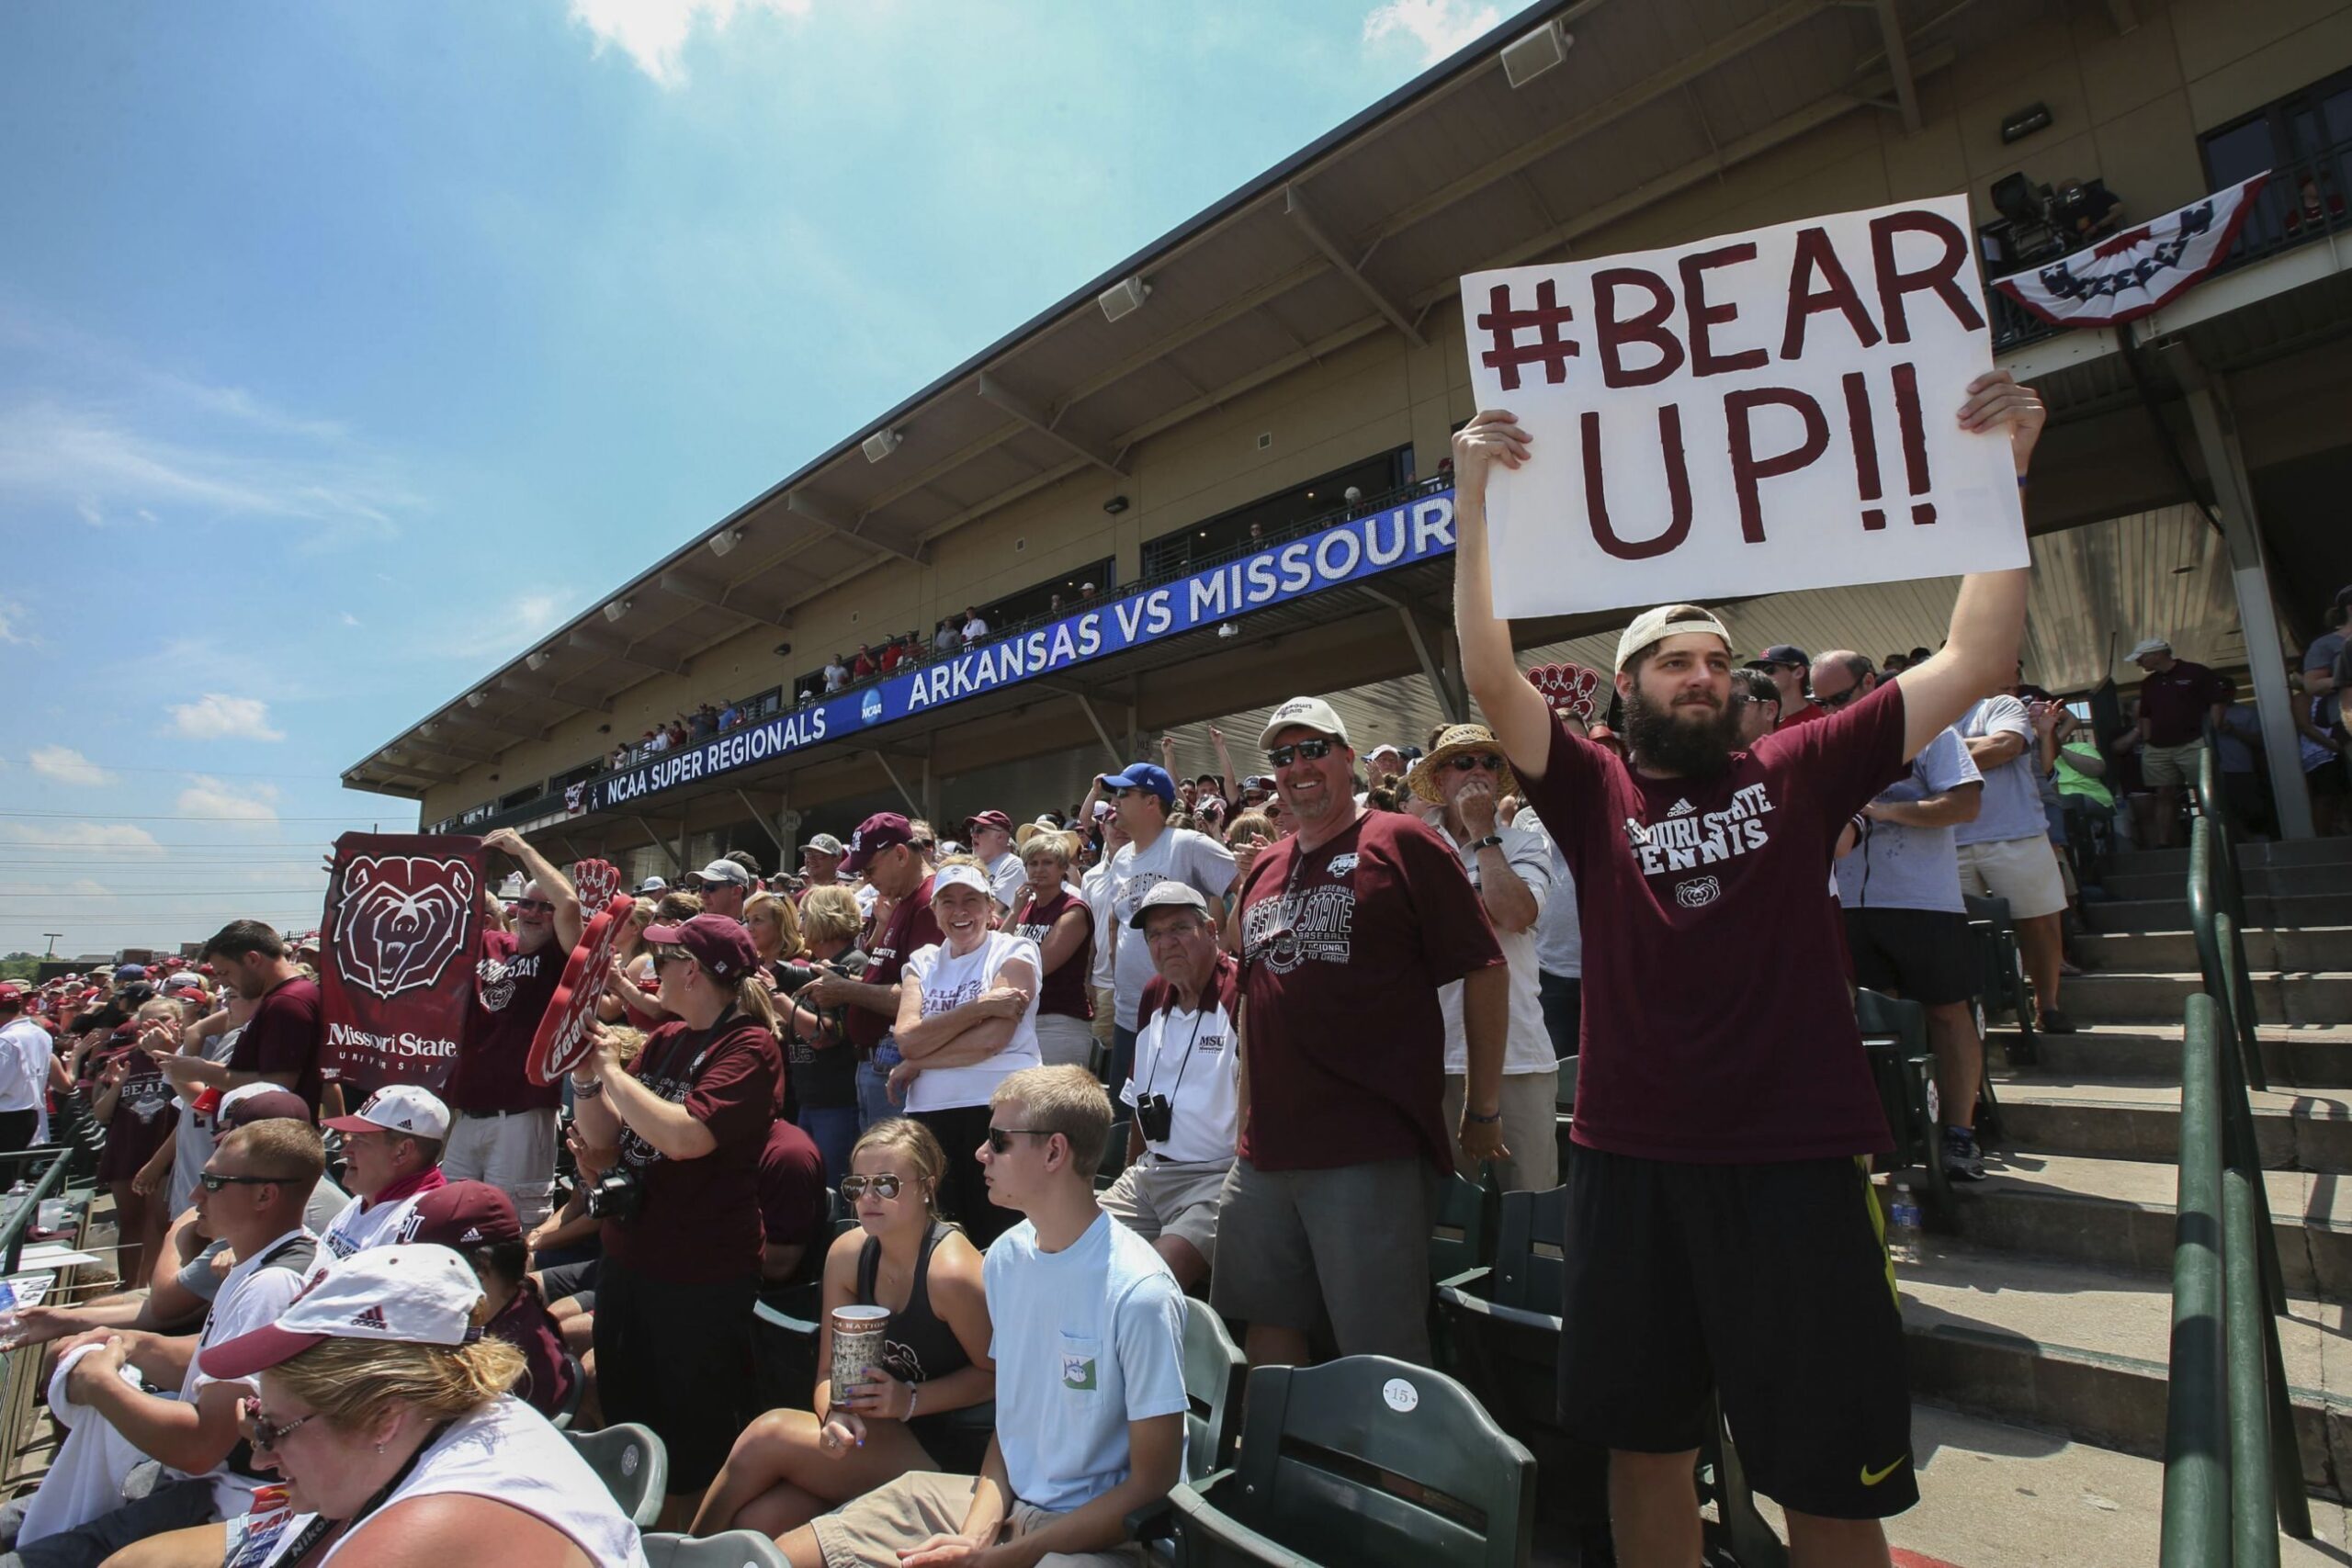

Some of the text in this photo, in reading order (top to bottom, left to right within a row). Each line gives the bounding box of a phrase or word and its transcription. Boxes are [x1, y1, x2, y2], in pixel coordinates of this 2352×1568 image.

[1476, 210, 1986, 390] #BEAR
[1580, 363, 1937, 560] UP!!
[908, 497, 1456, 711] ARKANSAS VS MISSOUR
[862, 703, 882, 720] NCAA
[607, 707, 826, 805] NCAA SUPER REGIONALS
[1623, 783, 1772, 848] SOURI STATE
[1319, 884, 1355, 897] BASEBALL
[1296, 892, 1355, 933] STATE
[1298, 931, 1350, 941] BASEBALL
[398, 1032, 457, 1057] State
[1199, 1035, 1226, 1047] MSU
[339, 1051, 443, 1073] UNIVRSIT
[1392, 1387, 1408, 1404] 15
[291, 1520, 327, 1558] Niko
